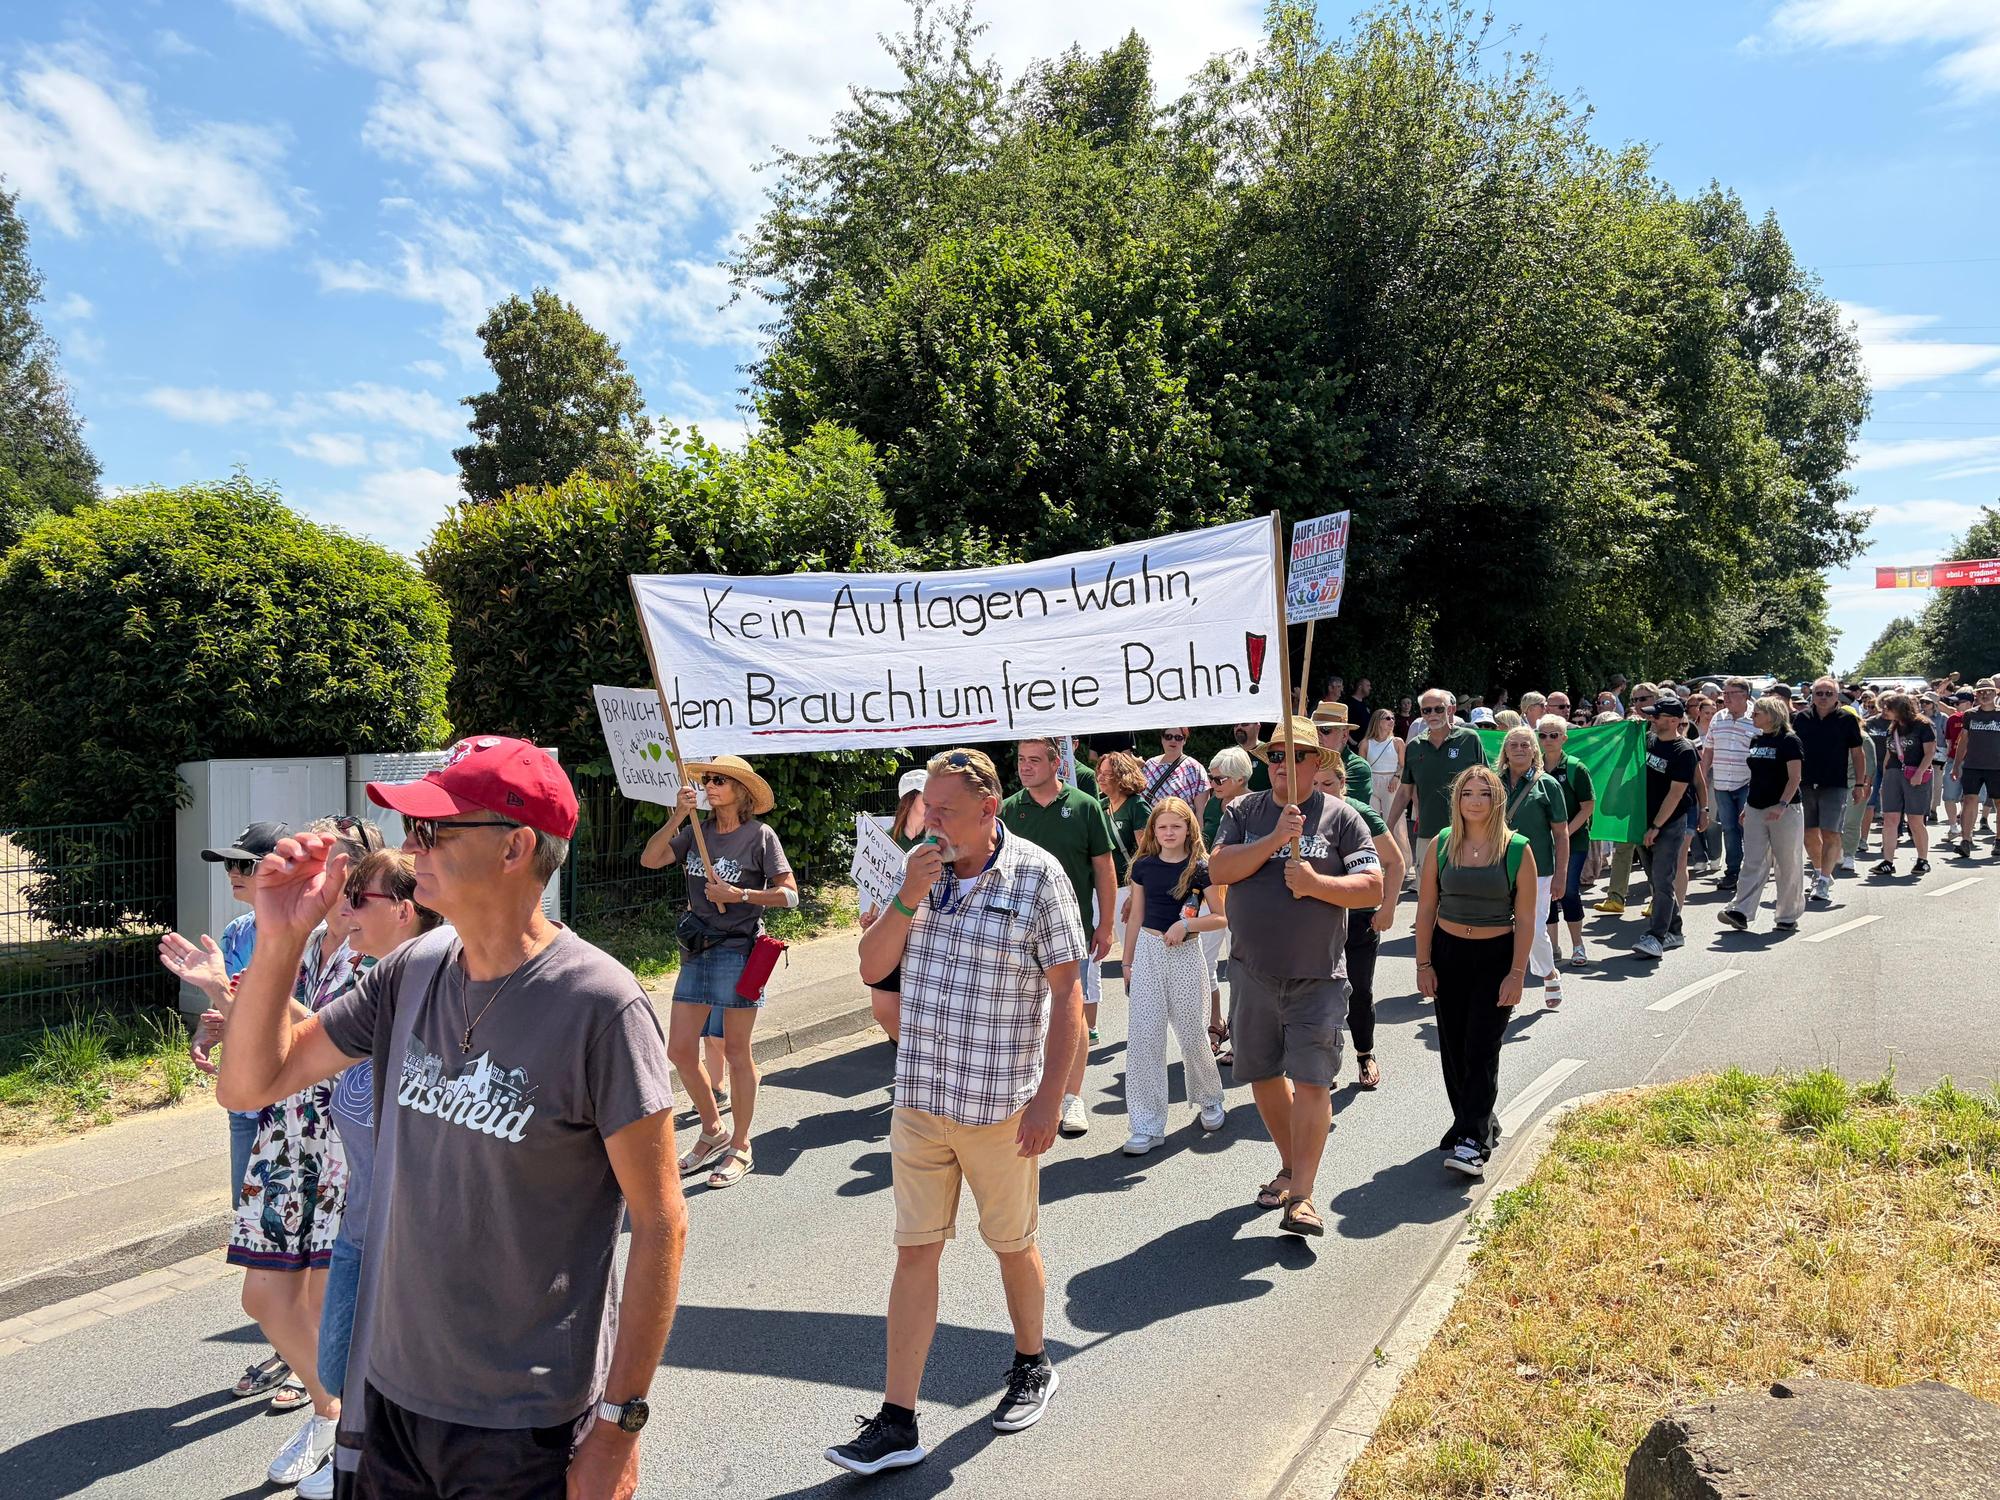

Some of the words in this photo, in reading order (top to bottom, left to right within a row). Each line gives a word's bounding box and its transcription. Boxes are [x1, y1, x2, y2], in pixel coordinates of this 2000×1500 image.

[1294, 515, 1342, 542] AUFLAGEN
[702, 585, 807, 640] Kein
[828, 553, 1199, 640] Auflagen-Wahn,
[670, 676, 734, 730] dem
[747, 665, 994, 726] Brauchtum
[1002, 659, 1099, 729] freie
[1121, 631, 1267, 706] Bahn!
[601, 698, 665, 723] BRAUCHT
[629, 728, 671, 754] VERBINDE
[864, 821, 896, 863] Weniger
[1345, 856, 1378, 871] RDNER
[398, 1073, 535, 1143] ttscheid
